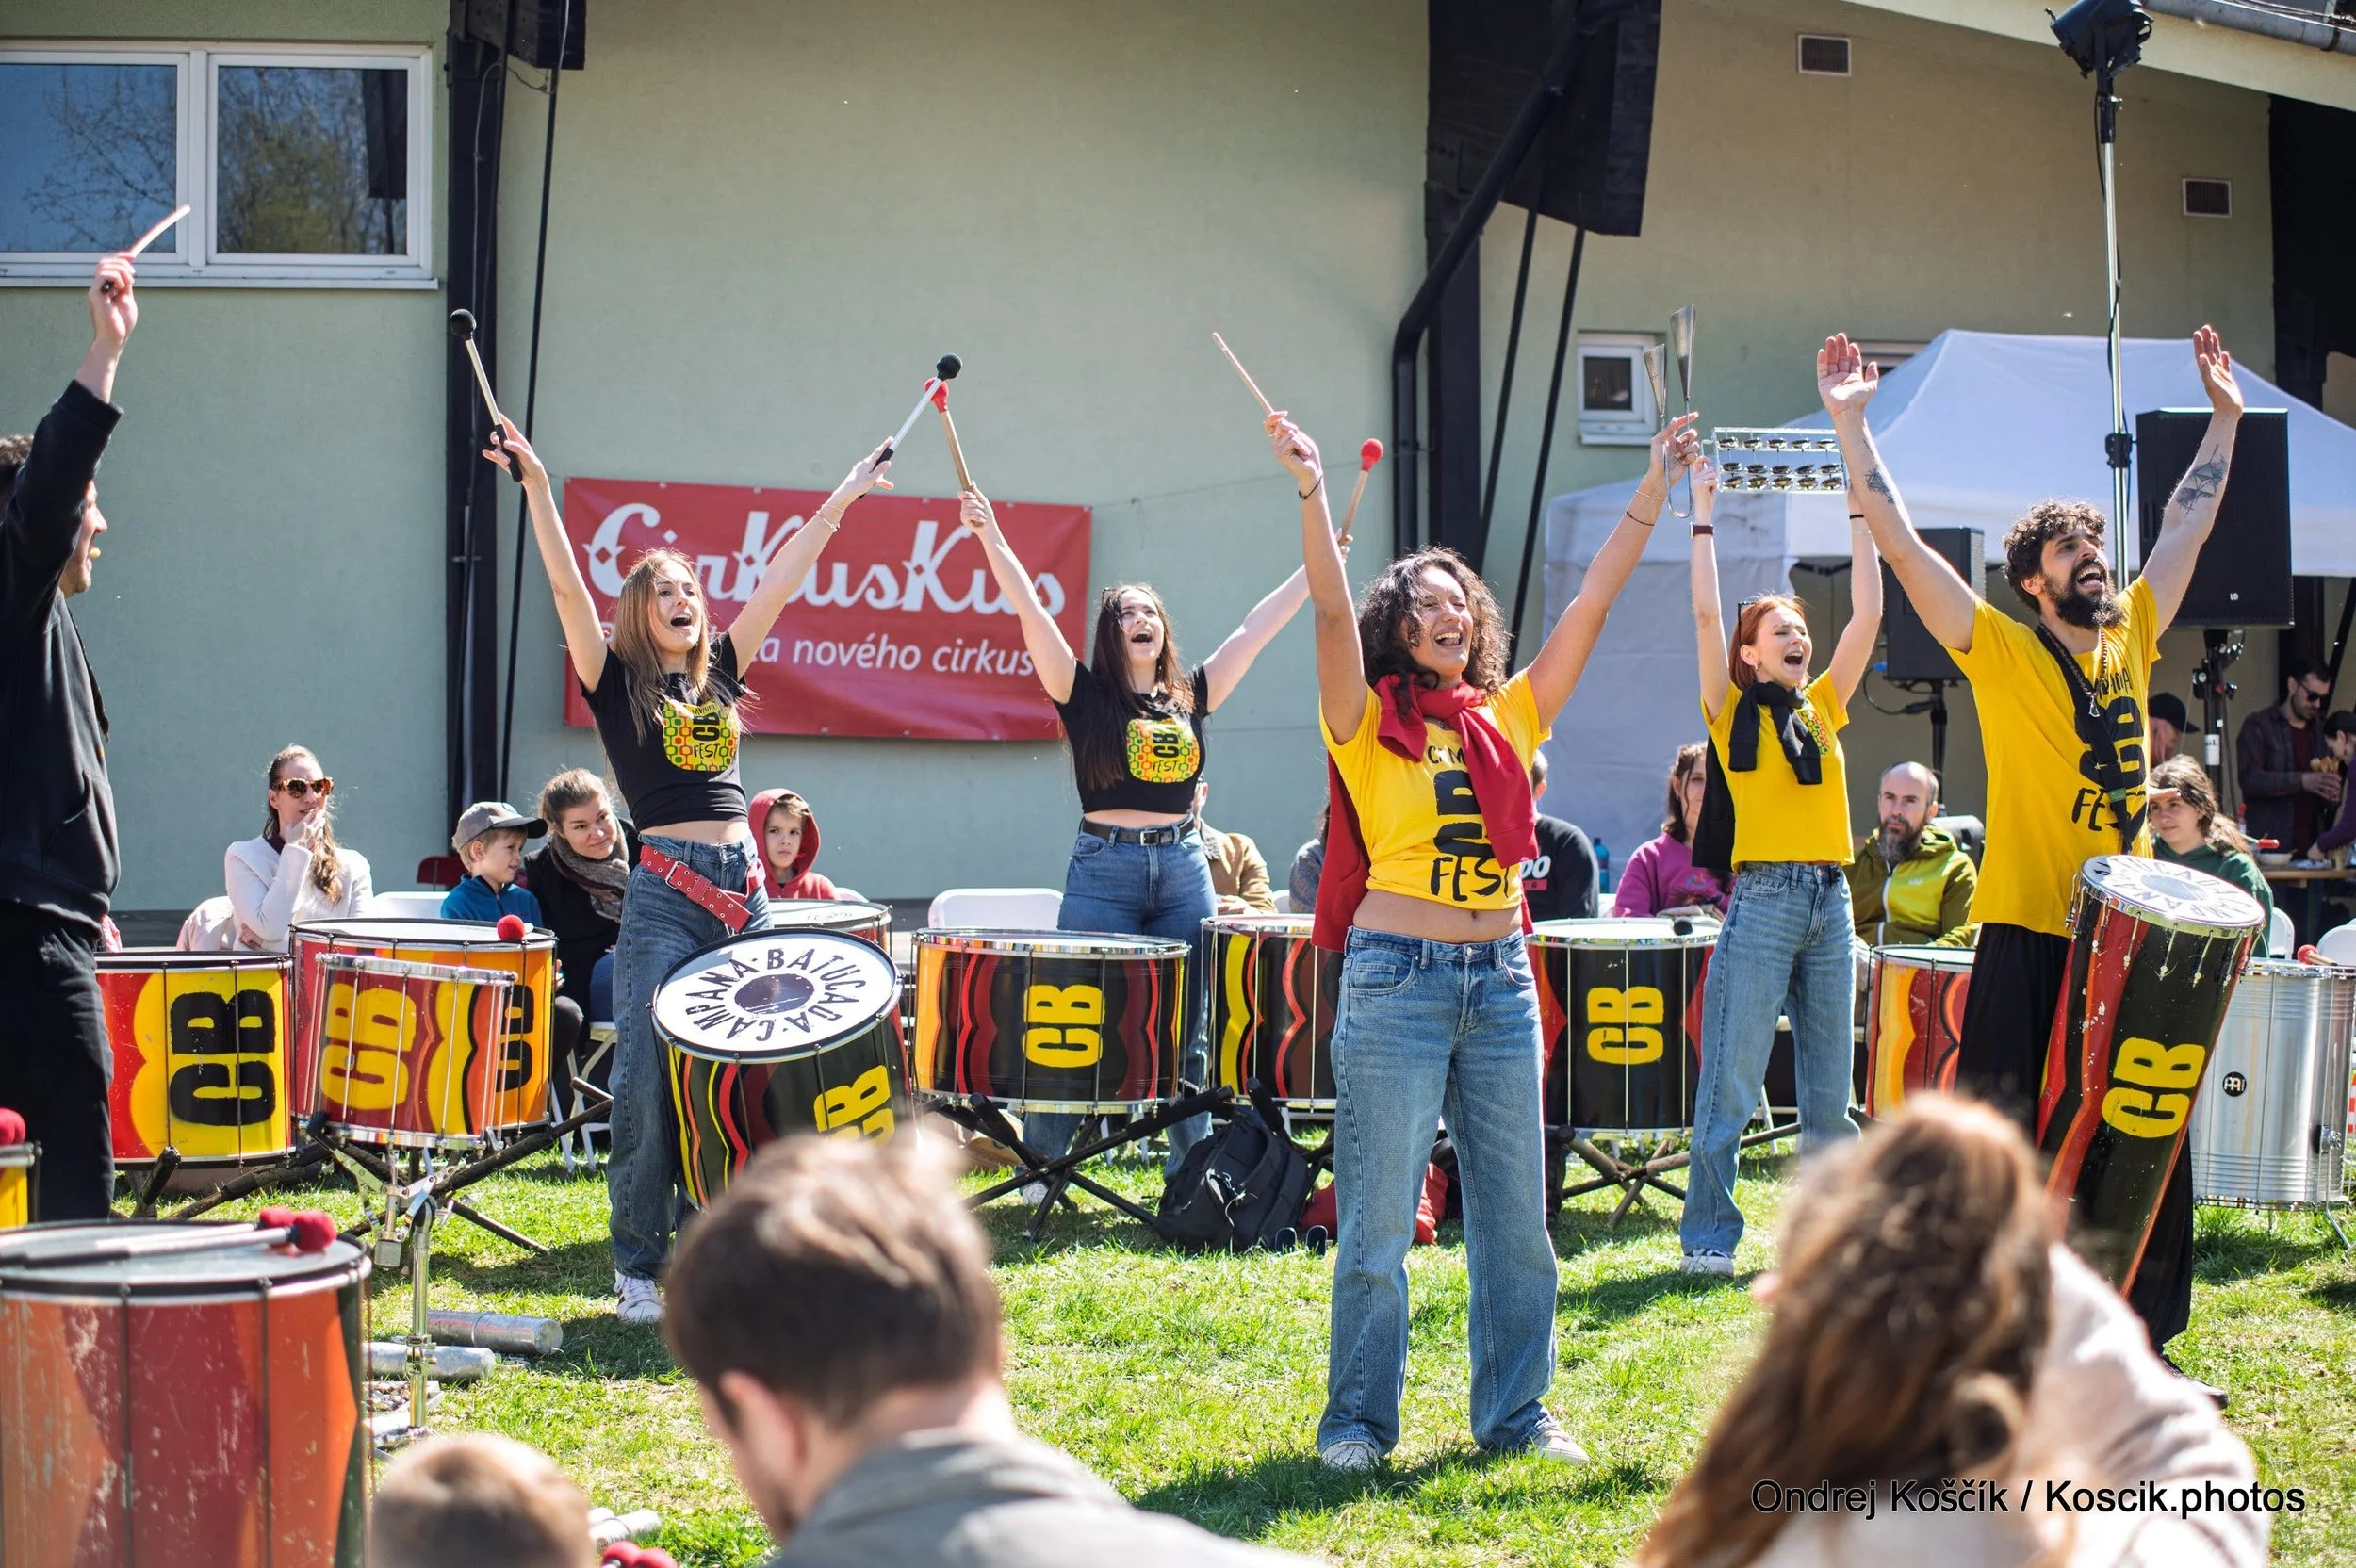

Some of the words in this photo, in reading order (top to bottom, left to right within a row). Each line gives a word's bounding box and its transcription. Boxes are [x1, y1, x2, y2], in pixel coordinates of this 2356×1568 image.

[582, 503, 1066, 617] CrKusKus
[793, 632, 921, 671] nového
[691, 712, 721, 742] CB
[693, 743, 721, 760] FEST
[1152, 732, 1180, 759] CB
[685, 957, 776, 1043] CAMPANA
[1023, 983, 1104, 1069] CB
[1586, 985, 1665, 1066] CB
[170, 988, 276, 1126] CB
[319, 982, 417, 1111] CB
[2101, 1036, 2206, 1139] CB
